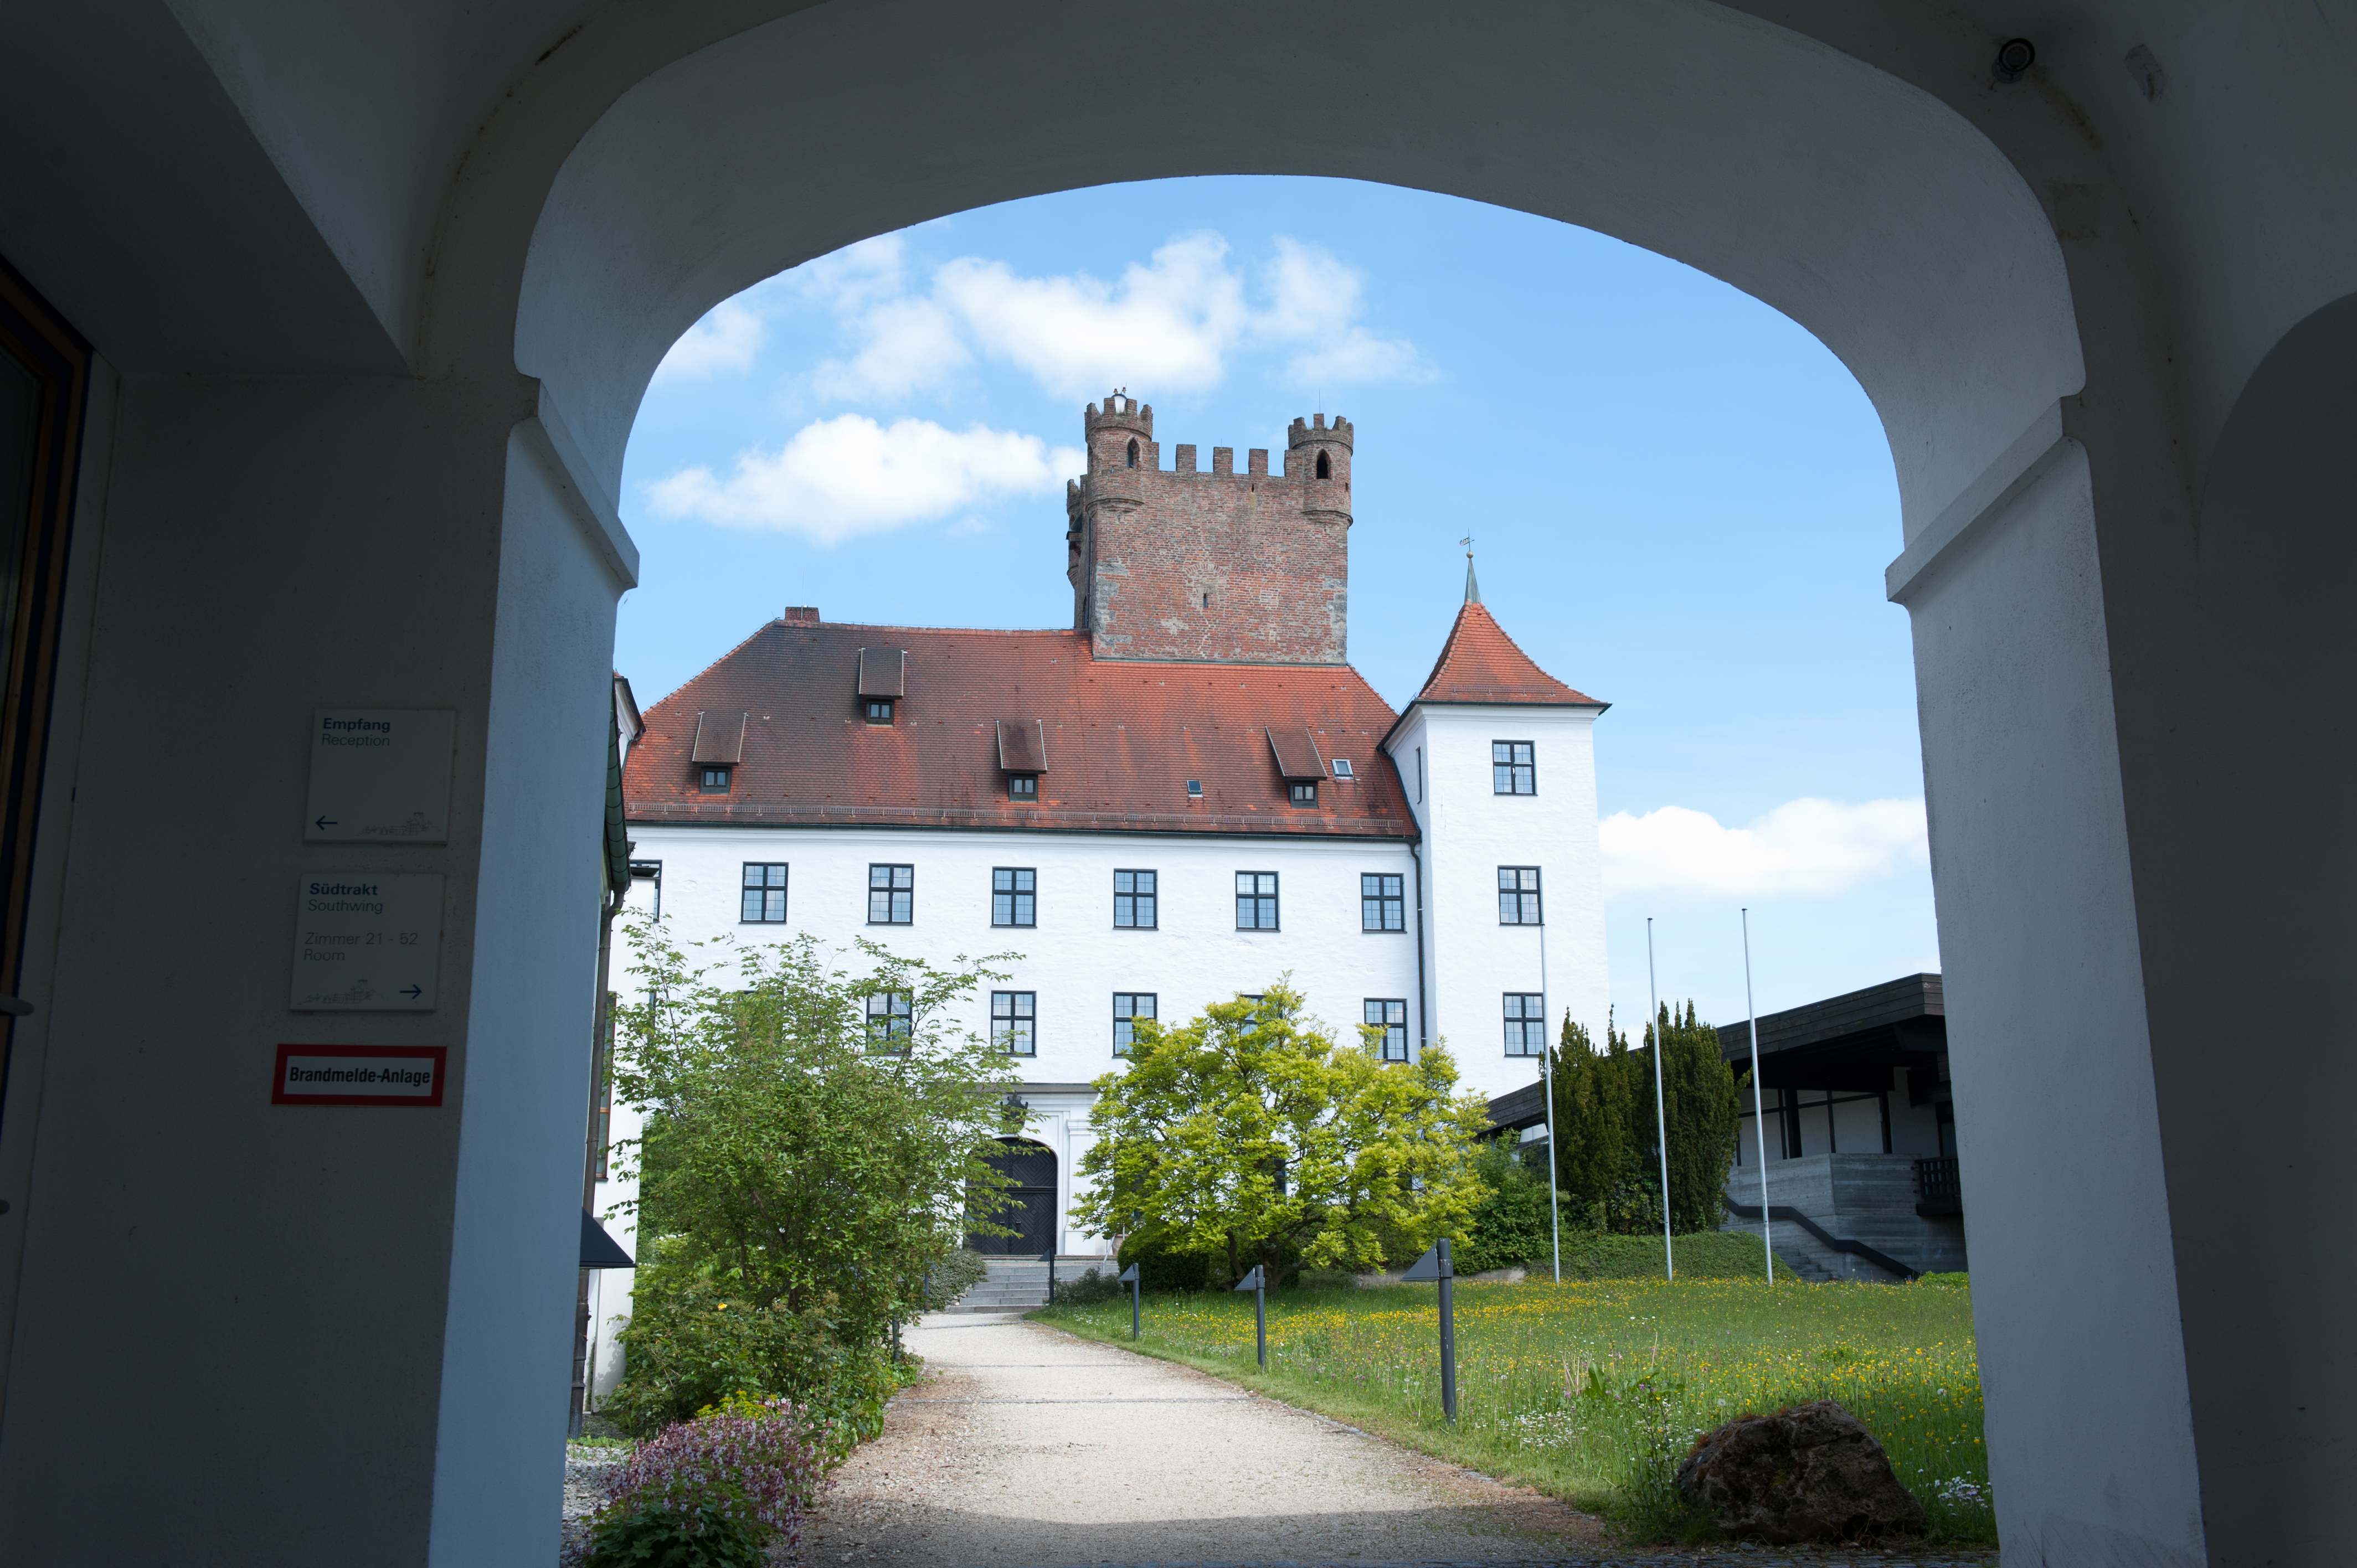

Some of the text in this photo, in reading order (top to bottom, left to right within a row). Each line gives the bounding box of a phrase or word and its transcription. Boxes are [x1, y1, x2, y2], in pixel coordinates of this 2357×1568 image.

[323, 718, 390, 733] Empfang
[322, 733, 390, 748] Reception
[309, 883, 378, 896] Südtrakt
[308, 899, 383, 915] Southwing
[305, 932, 361, 945] Zimmer
[366, 932, 383, 945] 21
[399, 933, 418, 945] 52
[304, 948, 345, 961] Room
[289, 1066, 430, 1087] Brandmelde-Anlage
